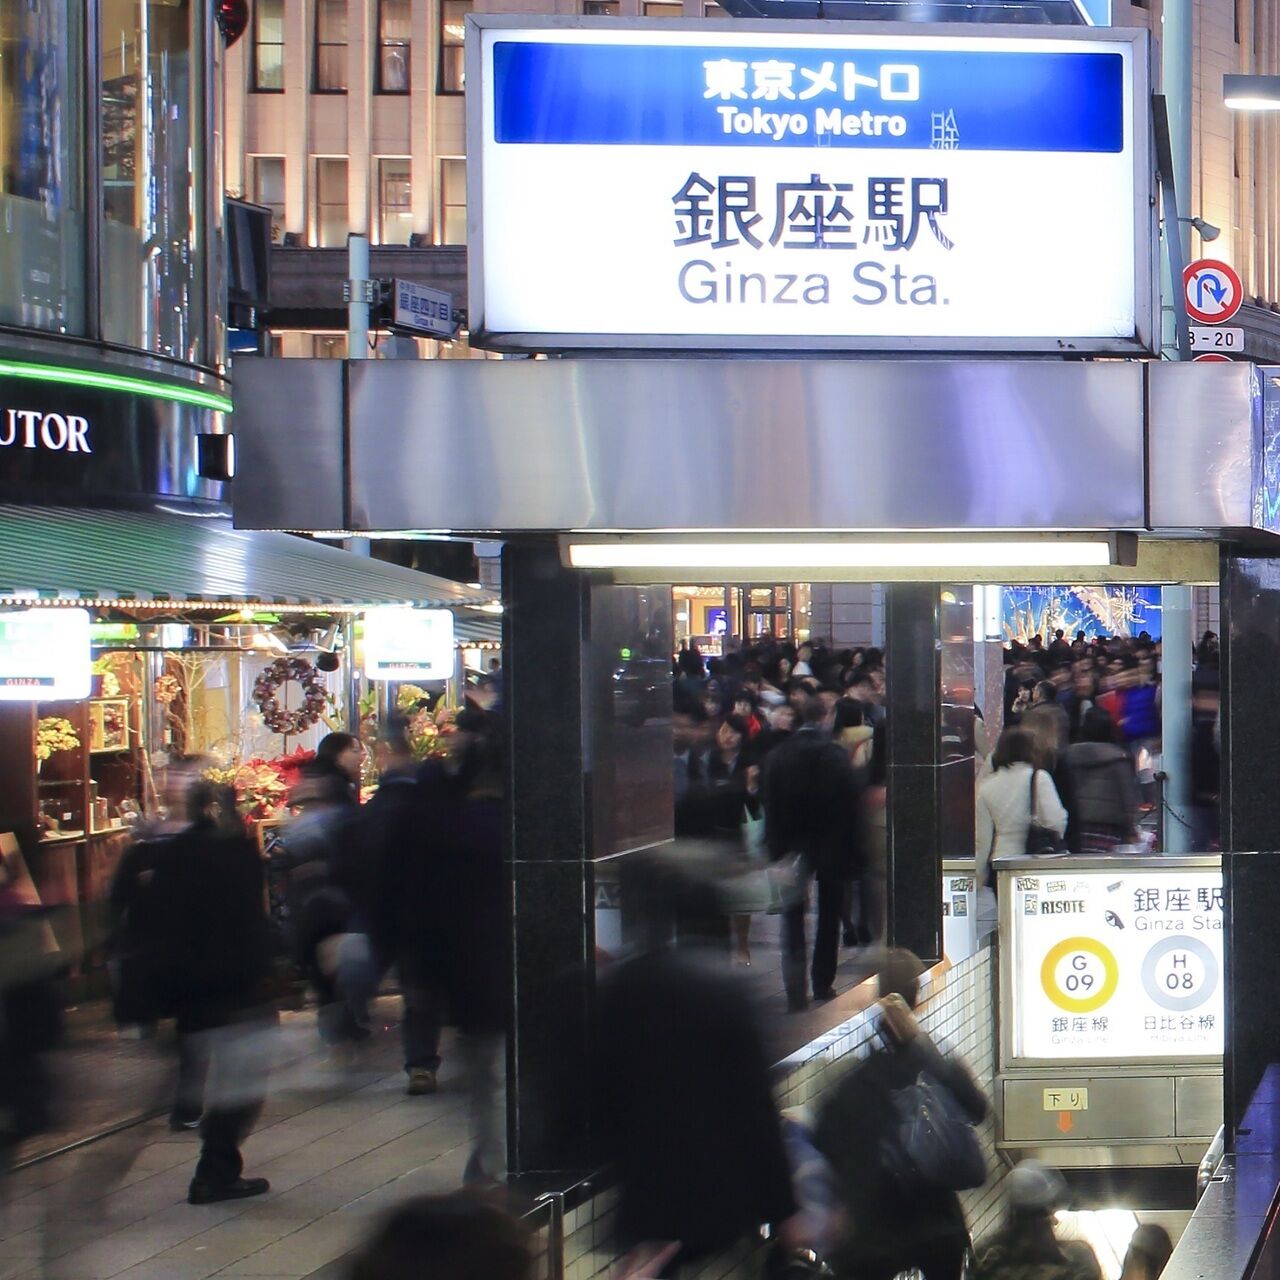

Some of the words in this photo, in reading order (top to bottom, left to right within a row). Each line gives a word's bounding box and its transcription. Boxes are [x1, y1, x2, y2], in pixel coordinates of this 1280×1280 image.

[702, 58, 921, 104] 東京メトロ
[717, 106, 808, 141] Tokyo
[815, 108, 907, 137] Metro
[671, 170, 956, 252] 銀座駅
[677, 258, 830, 305] Ginza
[851, 260, 951, 307] Sta.
[1133, 887, 1225, 913] 銀座駅
[1135, 915, 1184, 932] Ginza
[1072, 954, 1088, 971] G
[1173, 953, 1187, 969] H
[1065, 974, 1095, 992] 09
[1166, 972, 1194, 990] 08
[1051, 1016, 1109, 1032] 銀座線
[1144, 1015, 1215, 1031] 日比谷線
